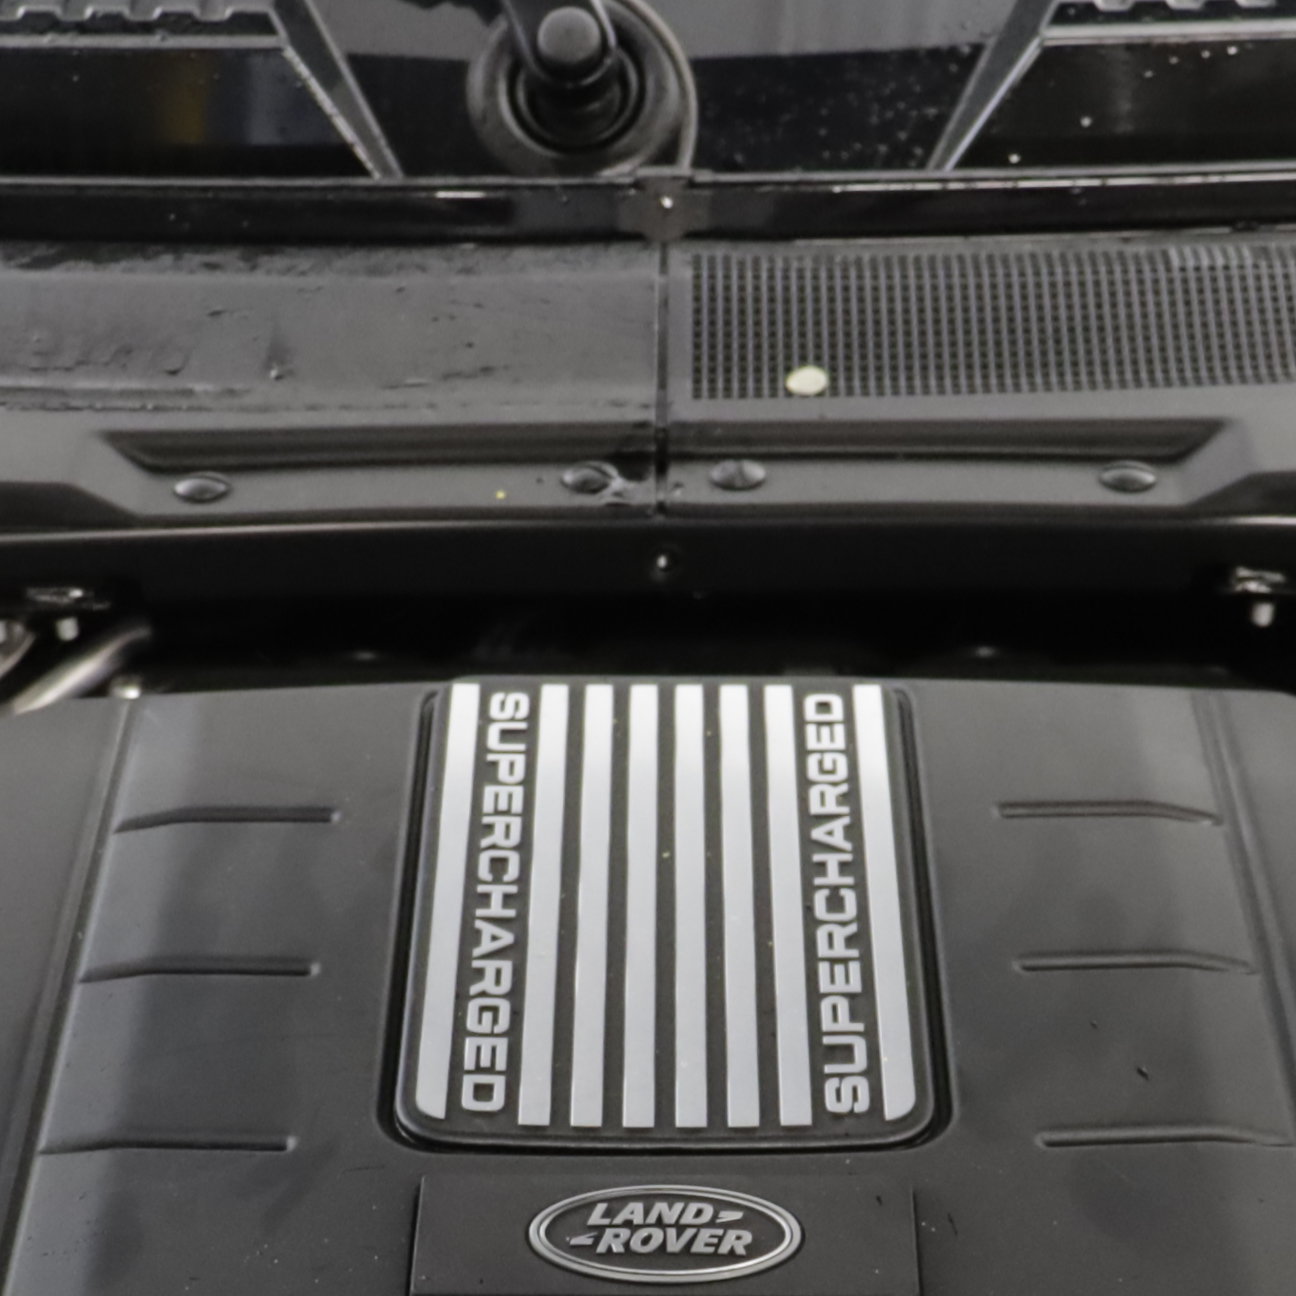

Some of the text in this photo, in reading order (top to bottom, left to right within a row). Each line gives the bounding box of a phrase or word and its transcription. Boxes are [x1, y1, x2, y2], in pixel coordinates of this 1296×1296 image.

[461, 691, 530, 1112] SUPERCHARGED
[804, 693, 870, 1114] SUPERCHARGED
[587, 1202, 714, 1226] LAND
[596, 1228, 752, 1255] ROVER
